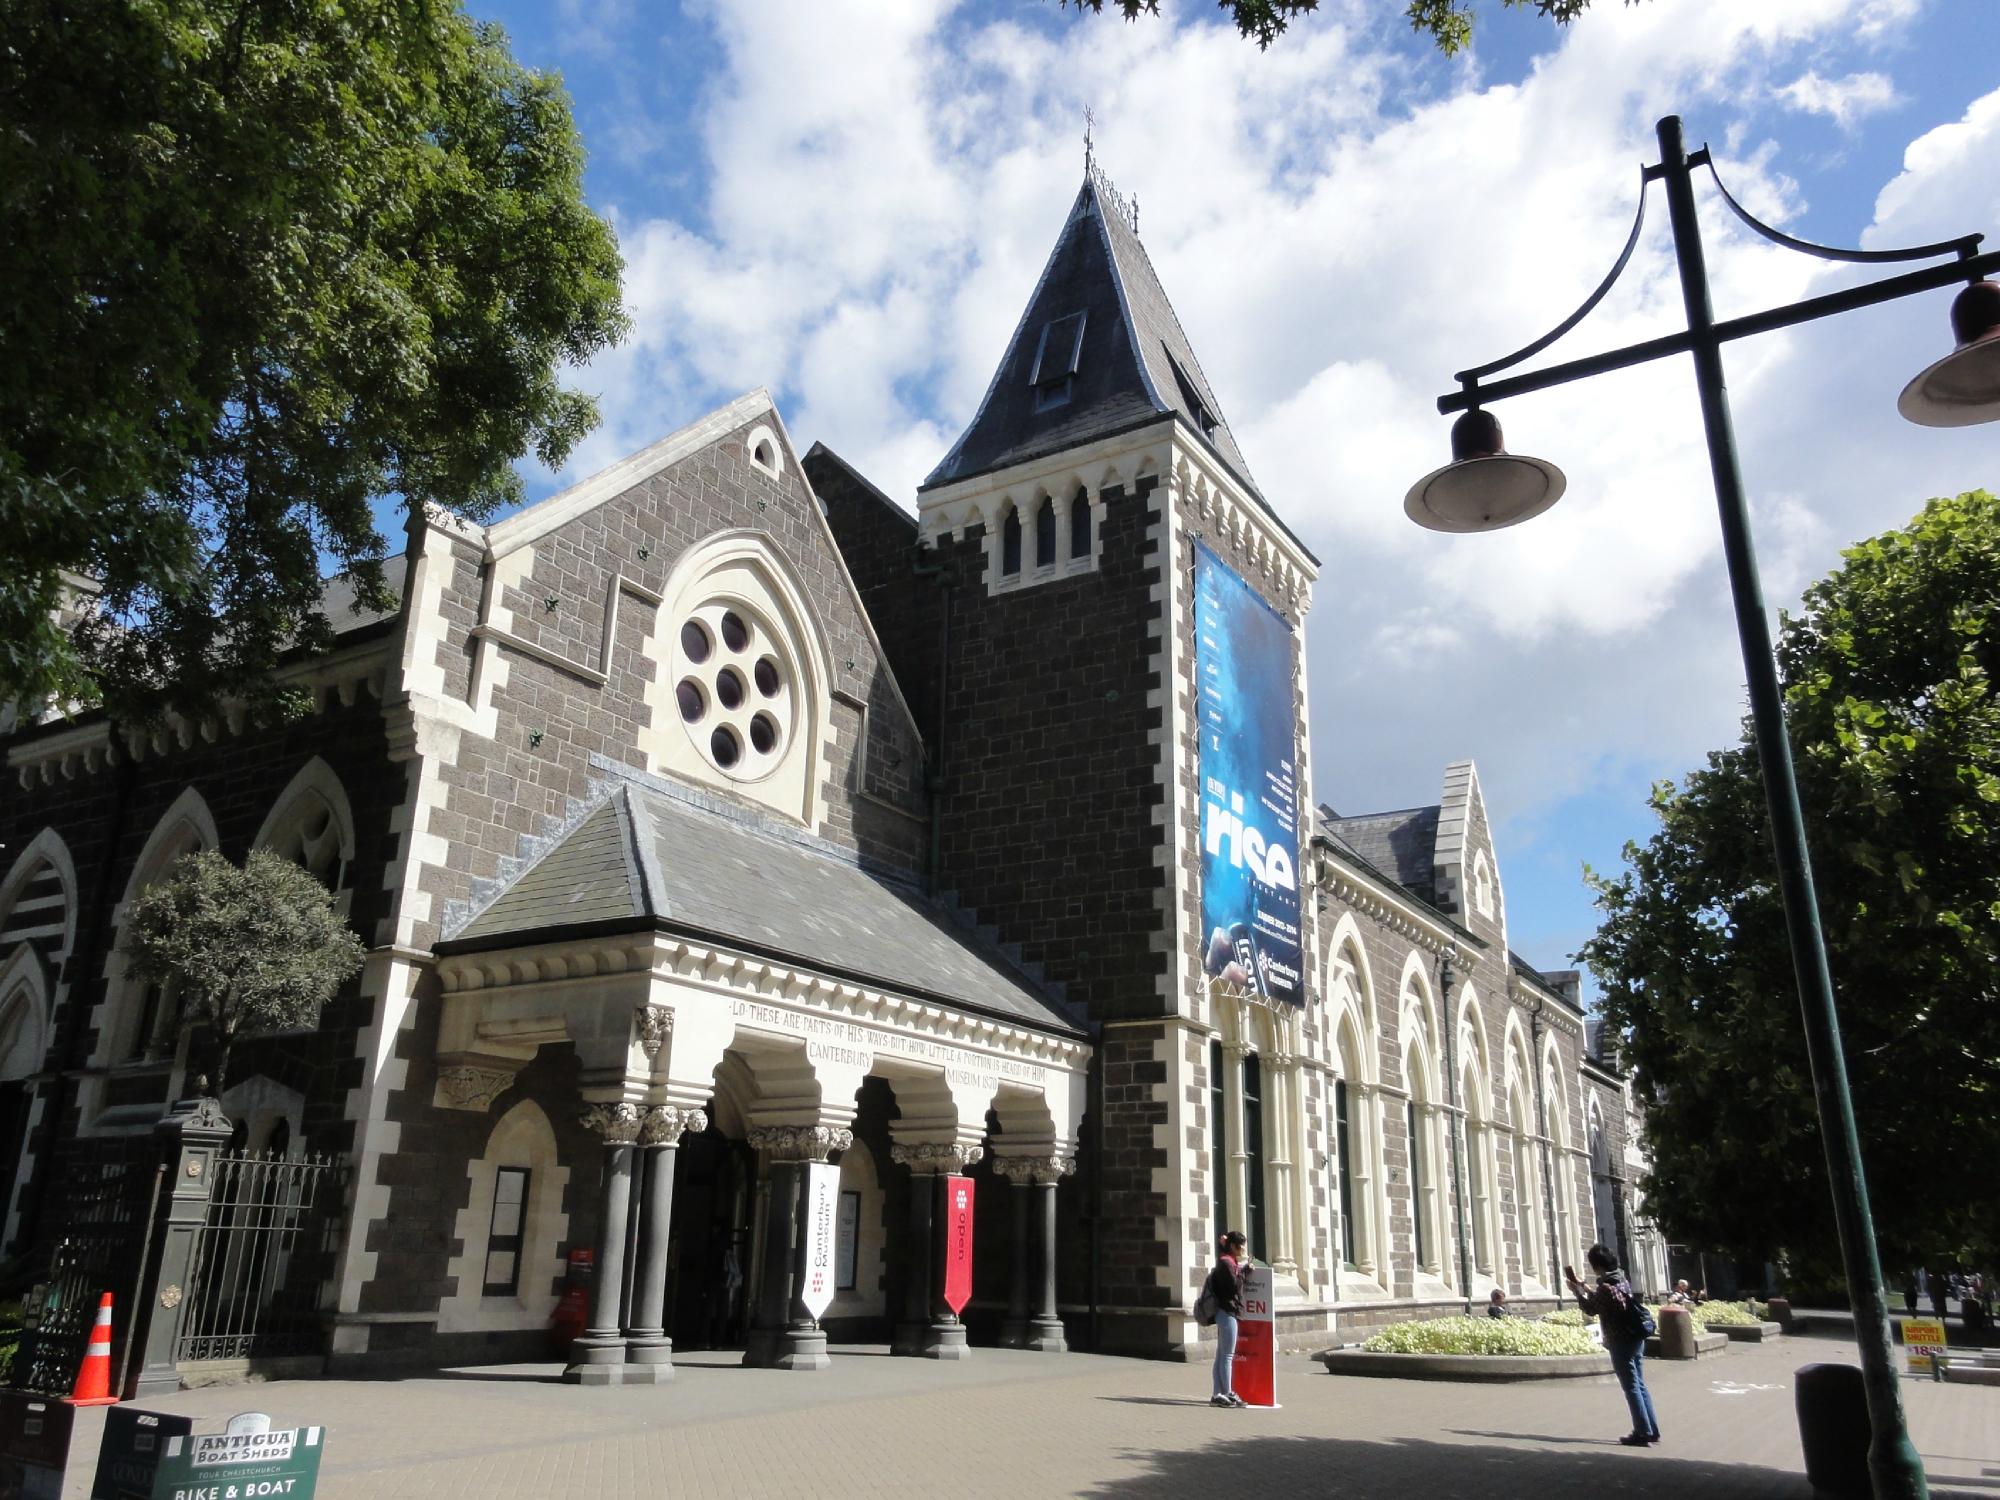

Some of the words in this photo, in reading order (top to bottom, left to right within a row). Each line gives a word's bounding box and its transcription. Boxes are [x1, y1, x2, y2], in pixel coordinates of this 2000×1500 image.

[1267, 957, 1299, 982] Canterbury
[1268, 971, 1293, 991] Museum
[732, 1001, 746, 1016] LO
[749, 1004, 780, 1025] THESE
[783, 1013, 800, 1030] ARE
[803, 1016, 831, 1034] PARTS
[834, 1023, 845, 1039] OF
[848, 1023, 864, 1043] HIS
[867, 1030, 888, 1047] WAYS
[891, 1036, 906, 1051] BUT
[908, 1040, 926, 1054] HOW
[928, 1044, 955, 1061] LITTLE
[957, 1051, 962, 1063] A
[963, 1051, 991, 1070] PORTION
[992, 1057, 1000, 1071] IS
[1023, 1065, 1030, 1078] OF
[1031, 1065, 1046, 1082] HIM
[809, 1041, 872, 1068] CANTERBURY
[946, 1068, 981, 1088] MUSEUM
[814, 1182, 827, 1267] Canterbury
[822, 1203, 831, 1267] Museum
[957, 1212, 966, 1260] open
[1246, 1300, 1266, 1314] EN
[200, 1432, 291, 1450] ANTIGUA
[198, 1450, 238, 1463] BOAT
[241, 1447, 289, 1460] SHEDS
[222, 1466, 281, 1478] CHRISTCHURCH
[175, 1487, 219, 1500] BIKE
[225, 1485, 238, 1499] &
[245, 1479, 296, 1497] BOAT
